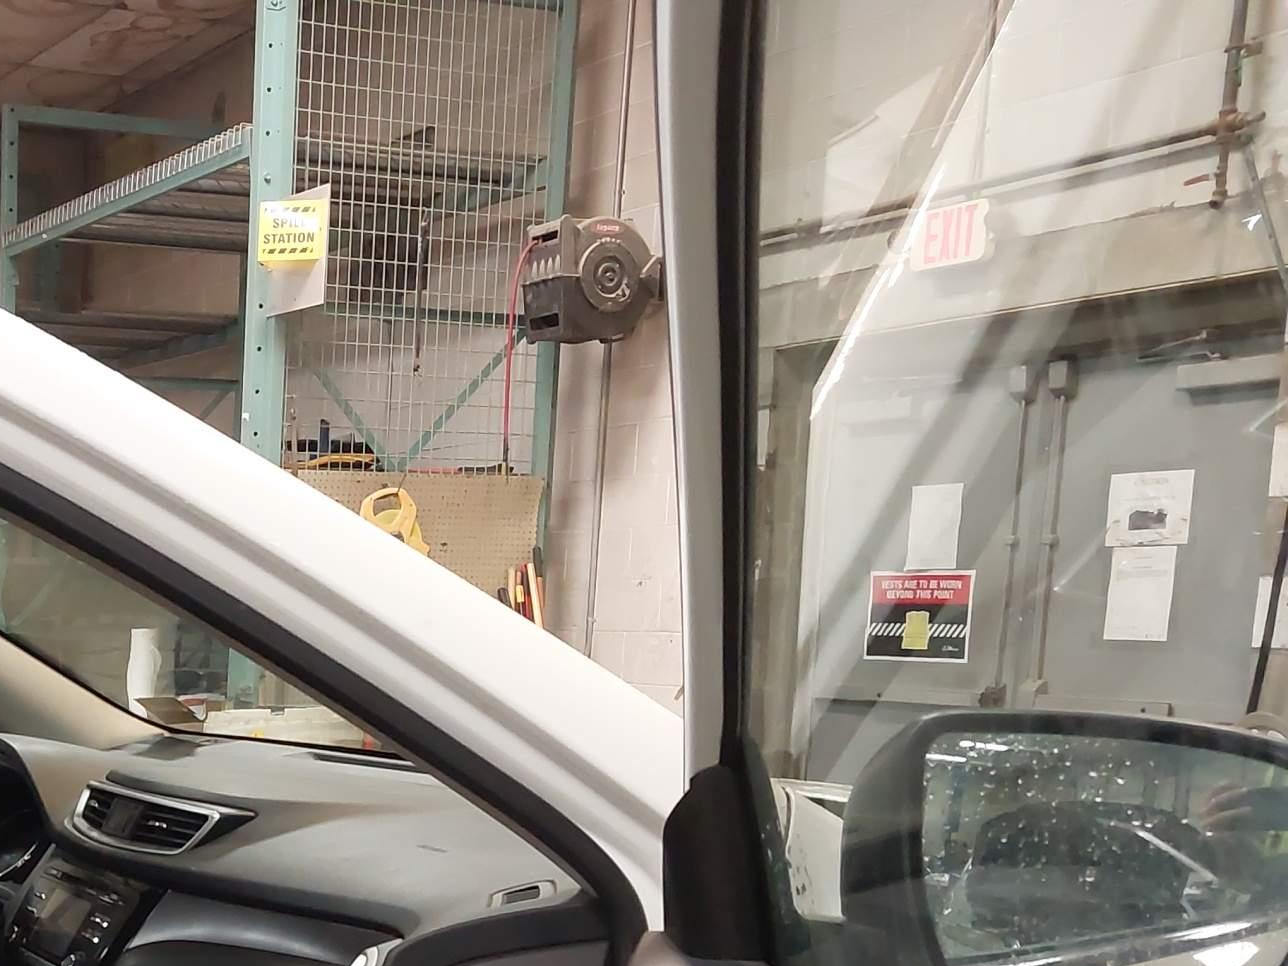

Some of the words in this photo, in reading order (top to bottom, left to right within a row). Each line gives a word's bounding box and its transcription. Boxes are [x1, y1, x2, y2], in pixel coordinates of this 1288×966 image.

[263, 231, 315, 245] STATION
[923, 203, 979, 265] EXIT
[881, 580, 903, 590] VESTS
[904, 580, 918, 589] ARE
[919, 580, 929, 589] TO
[929, 580, 938, 589] BE
[939, 580, 962, 590] WORN
[886, 590, 914, 599] BEYOND
[916, 590, 932, 599] THIS
[933, 590, 954, 599] POINT
